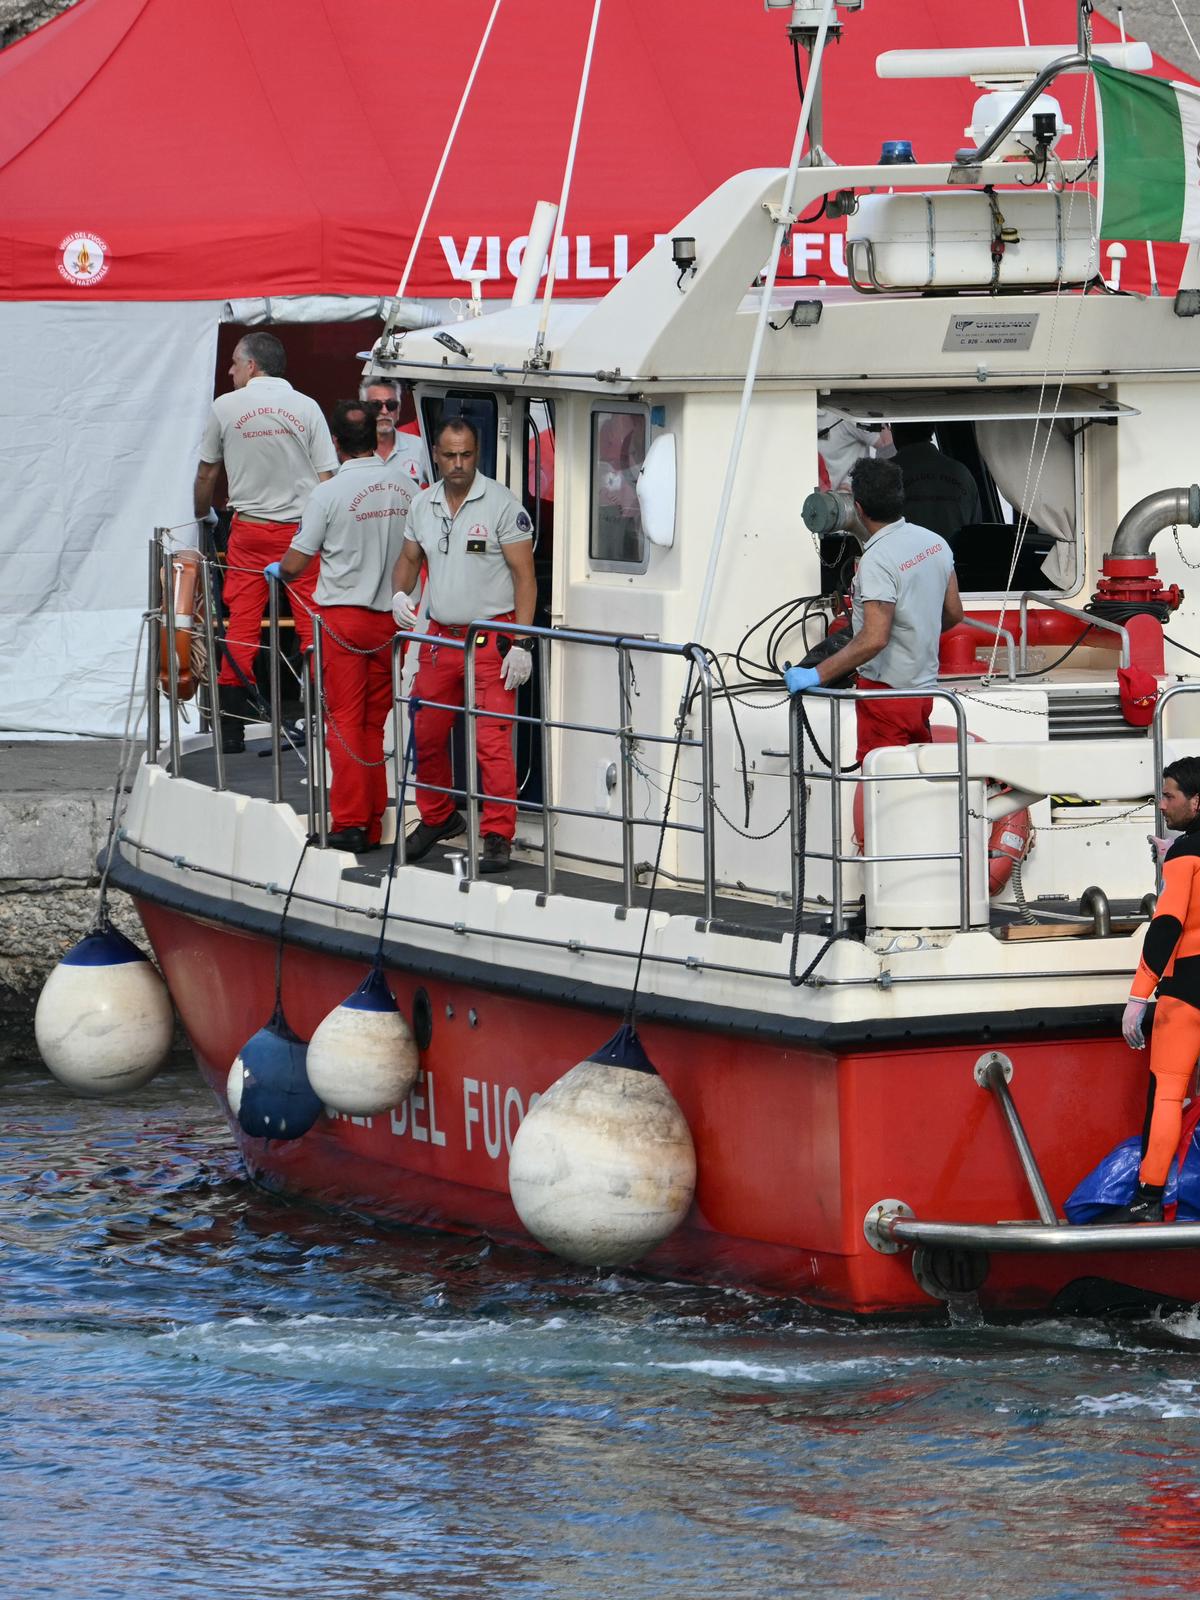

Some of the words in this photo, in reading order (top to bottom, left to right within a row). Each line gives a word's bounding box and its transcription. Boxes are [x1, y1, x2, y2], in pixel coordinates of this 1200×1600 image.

[234, 410, 256, 430] VIGILI
[258, 407, 275, 415] DEL
[277, 408, 305, 432] FUOCO
[242, 429, 273, 439] SEZIONE
[348, 489, 368, 512] VIGILI
[368, 483, 385, 493] DEL
[388, 483, 413, 504] FUOC
[463, 1077, 544, 1160] FUO
